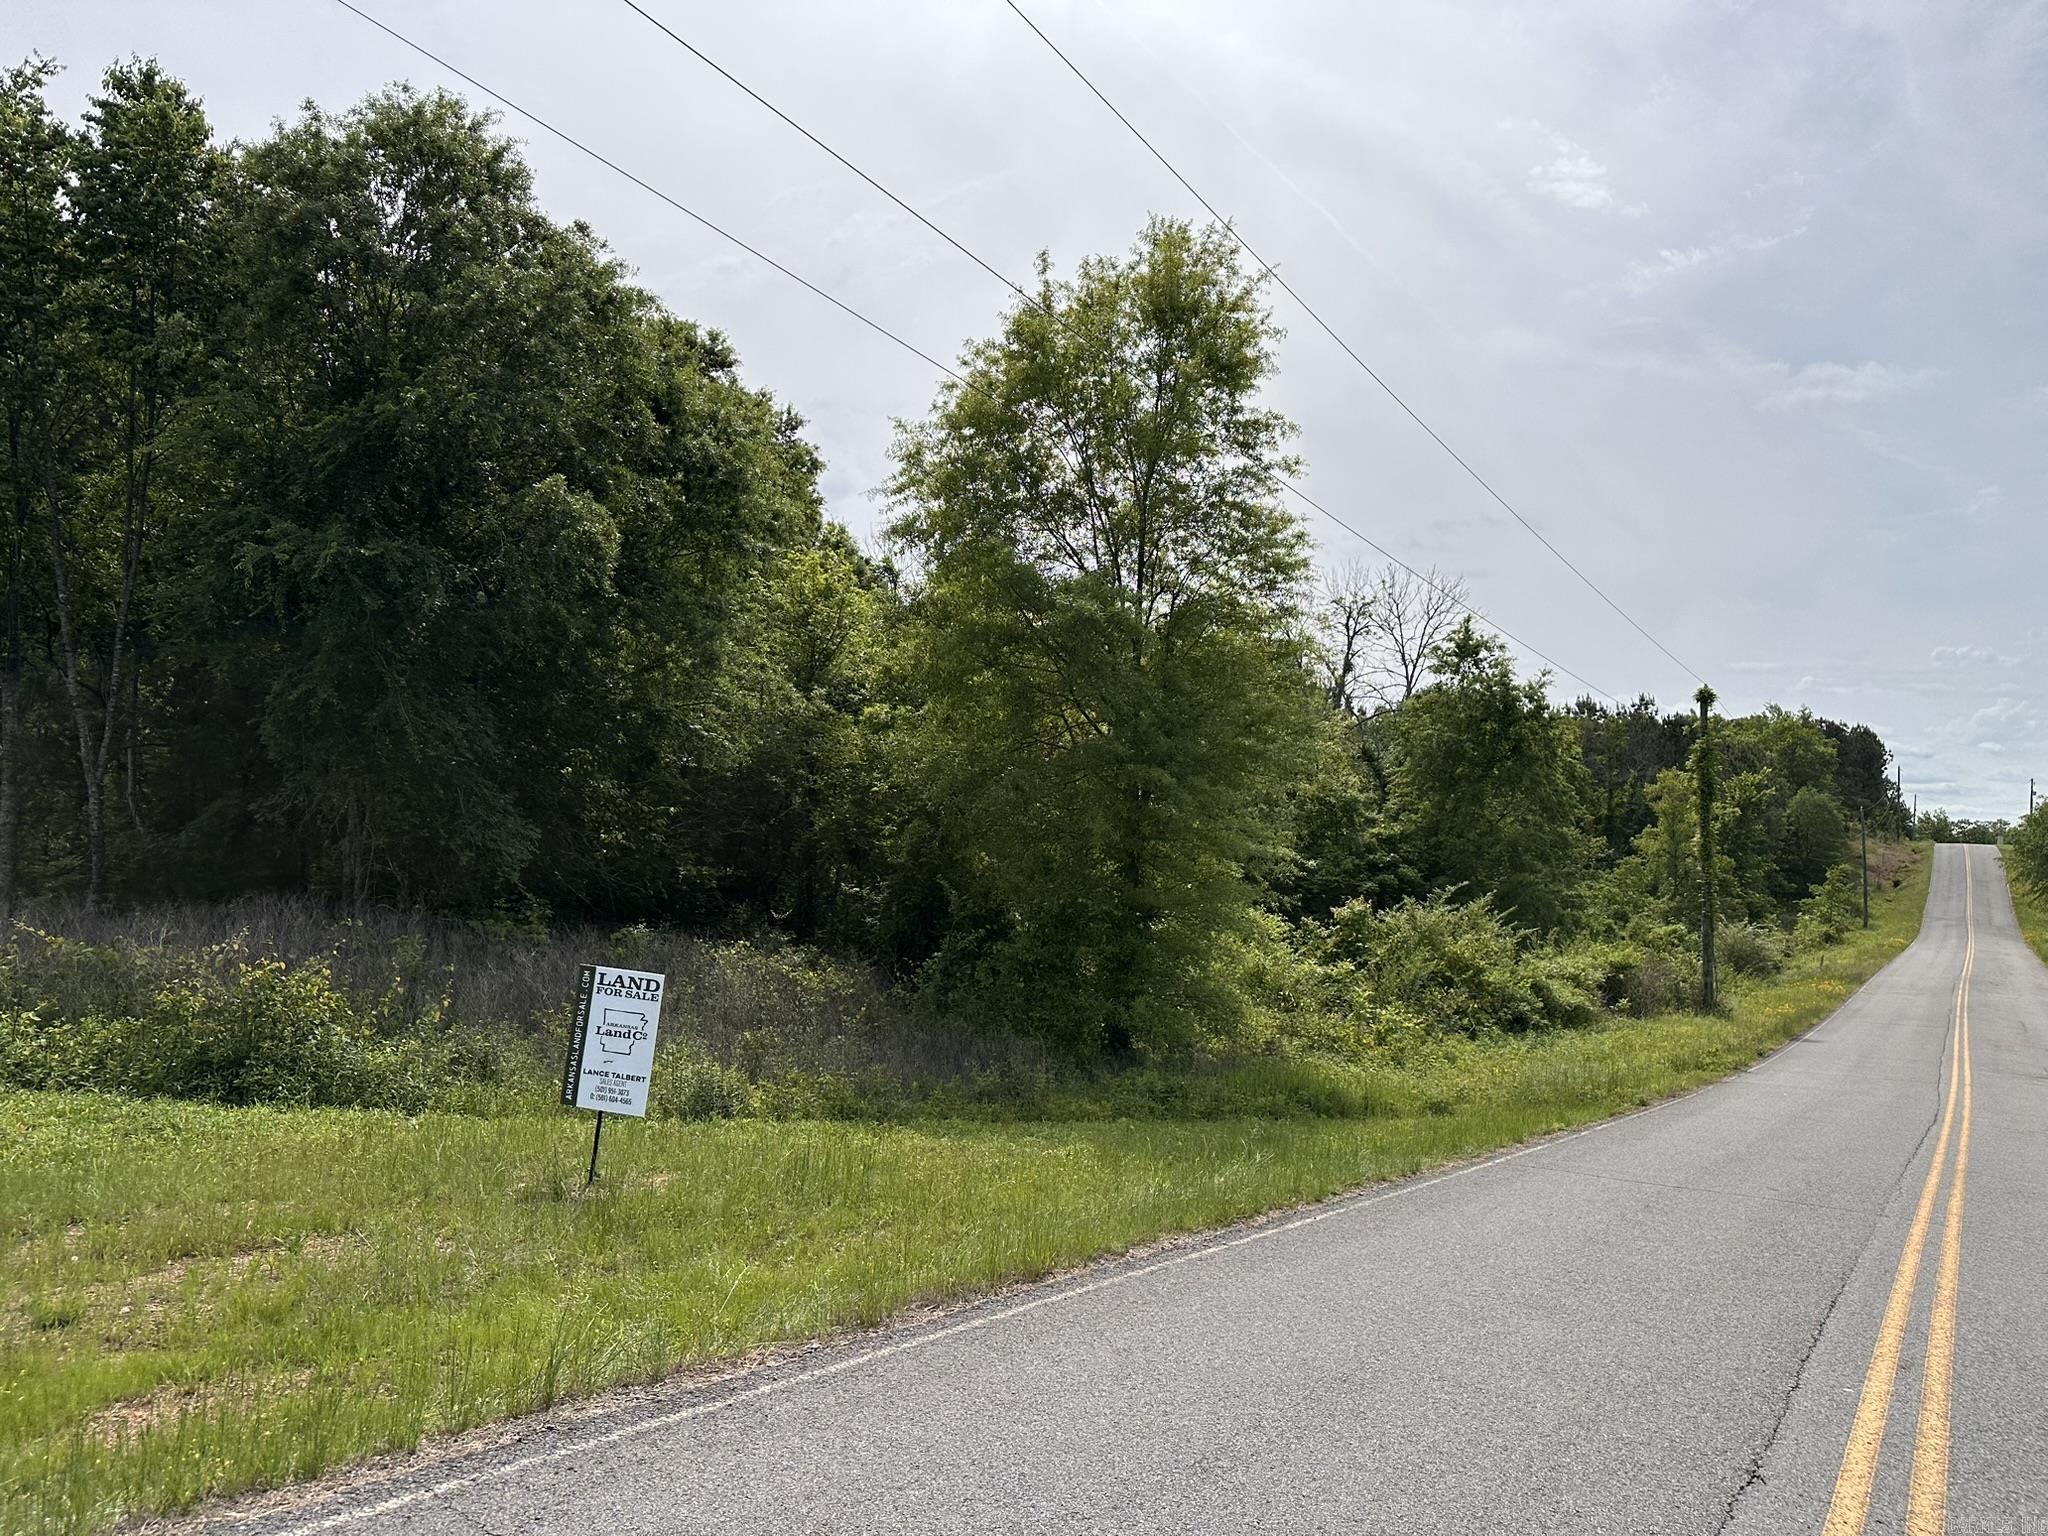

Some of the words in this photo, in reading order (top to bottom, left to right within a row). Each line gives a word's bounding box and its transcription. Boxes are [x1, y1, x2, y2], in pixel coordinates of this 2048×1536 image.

[597, 972, 661, 993] LAND
[596, 986, 623, 997] FOR
[624, 990, 660, 1002] SALE
[565, 970, 591, 1100] ARKANSASLANDFORSALE.COM
[583, 1068, 610, 1078] LANCE
[611, 1072, 647, 1083] TALBERT
[600, 1078, 612, 1086] SALES
[613, 1080, 627, 1088] AGENT
